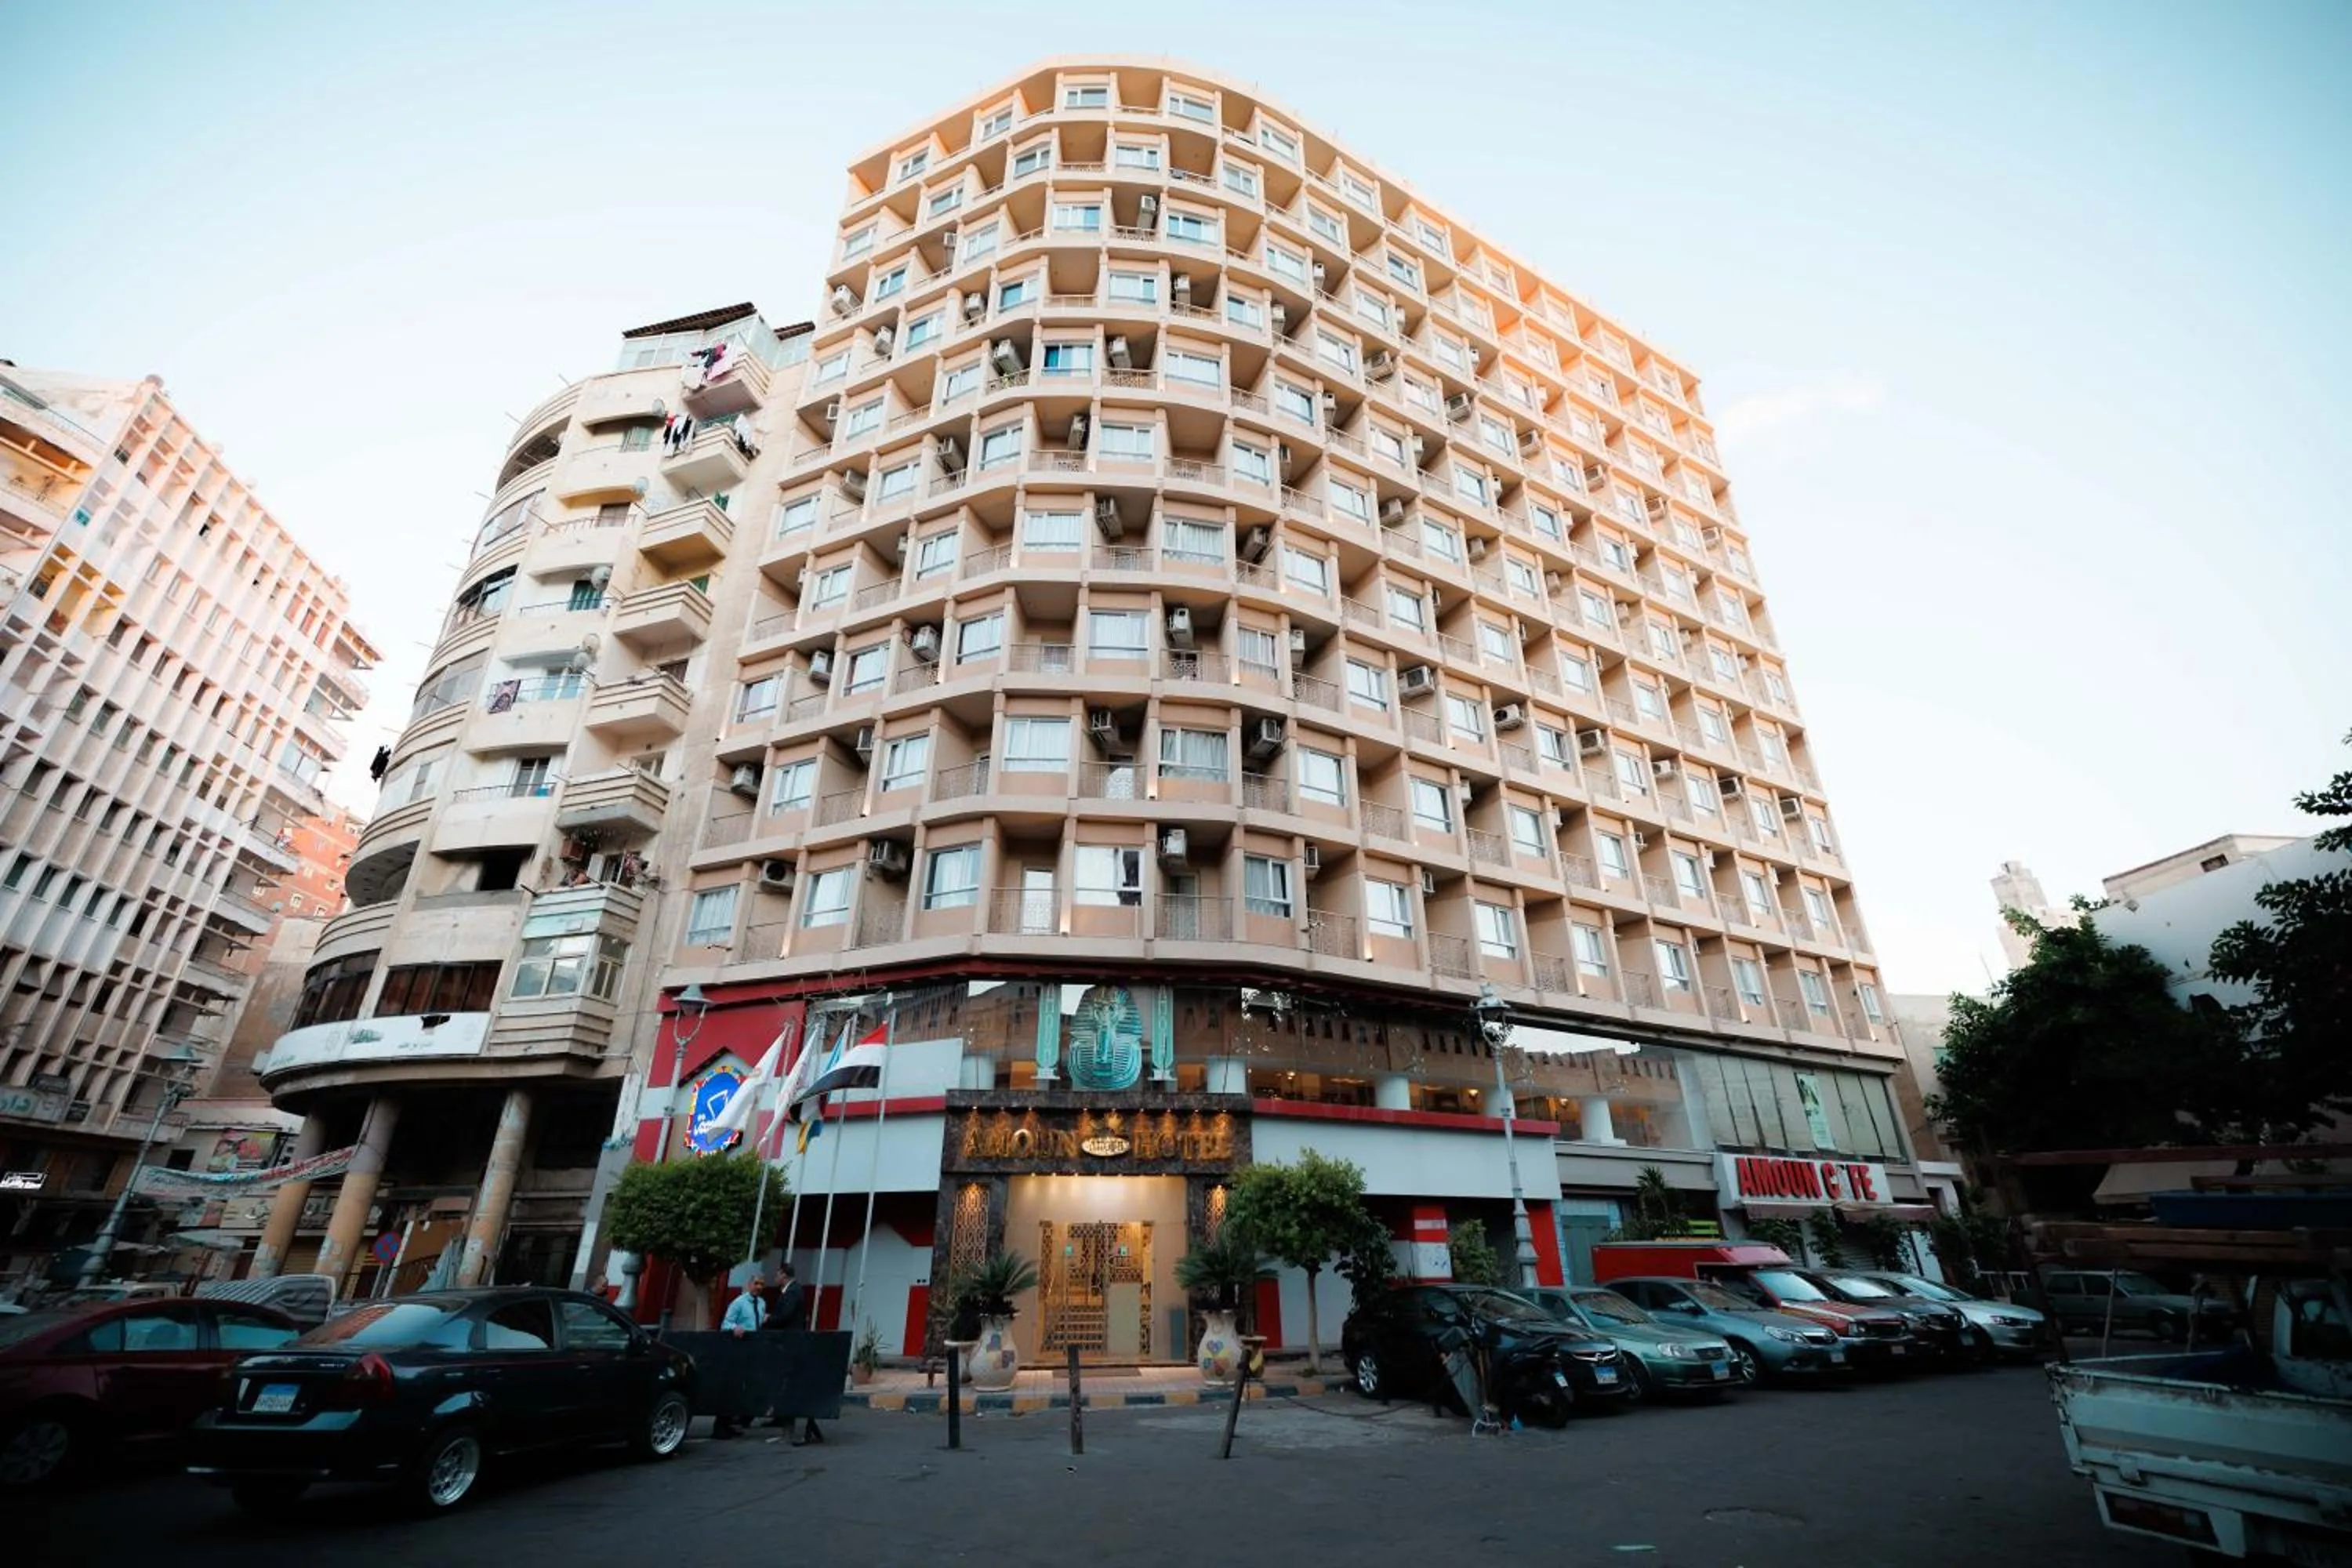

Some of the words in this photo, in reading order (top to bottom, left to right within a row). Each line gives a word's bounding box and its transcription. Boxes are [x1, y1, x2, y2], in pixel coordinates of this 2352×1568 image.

[965, 1127, 1079, 1157] AMOUN
[1133, 1130, 1232, 1160] HOTEL
[1735, 1157, 1823, 1200] AMOUN
[1820, 1161, 1878, 1201] CFE
